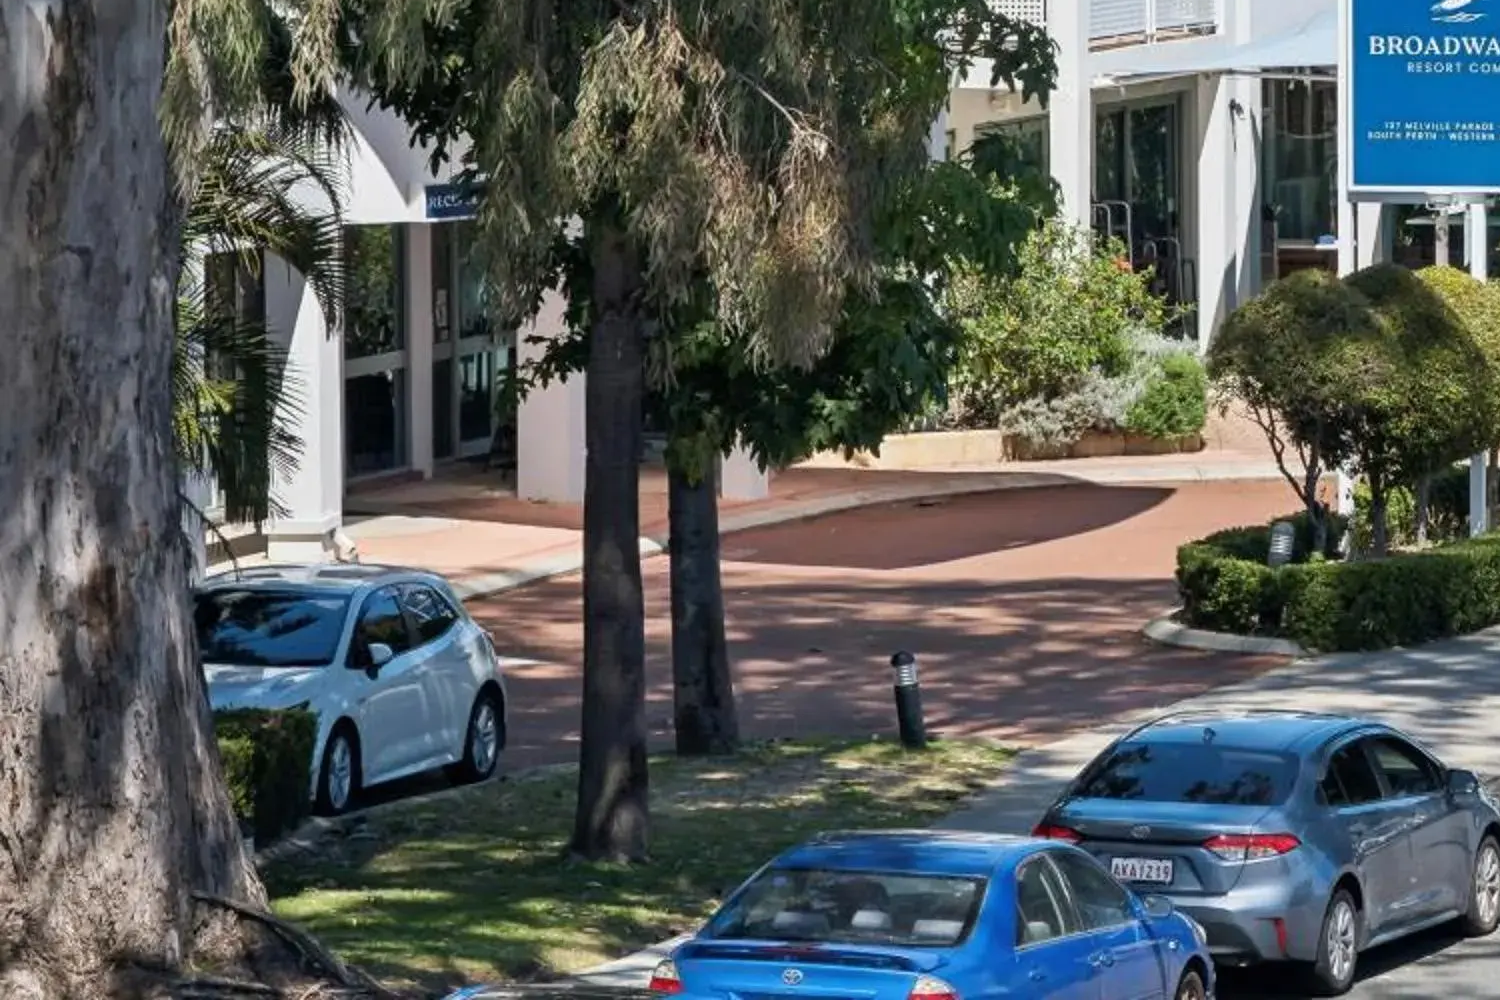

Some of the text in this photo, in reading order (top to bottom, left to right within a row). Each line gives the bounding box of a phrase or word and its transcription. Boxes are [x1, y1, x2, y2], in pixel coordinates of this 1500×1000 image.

[1407, 62, 1462, 73] RESORT
[1405, 121, 1451, 131] MELVILLE
[1455, 122, 1494, 131] PARADE
[1368, 131, 1401, 141] SOUTH
[1405, 131, 1437, 141] PERTH
[1448, 132, 1495, 141] WESTERN
